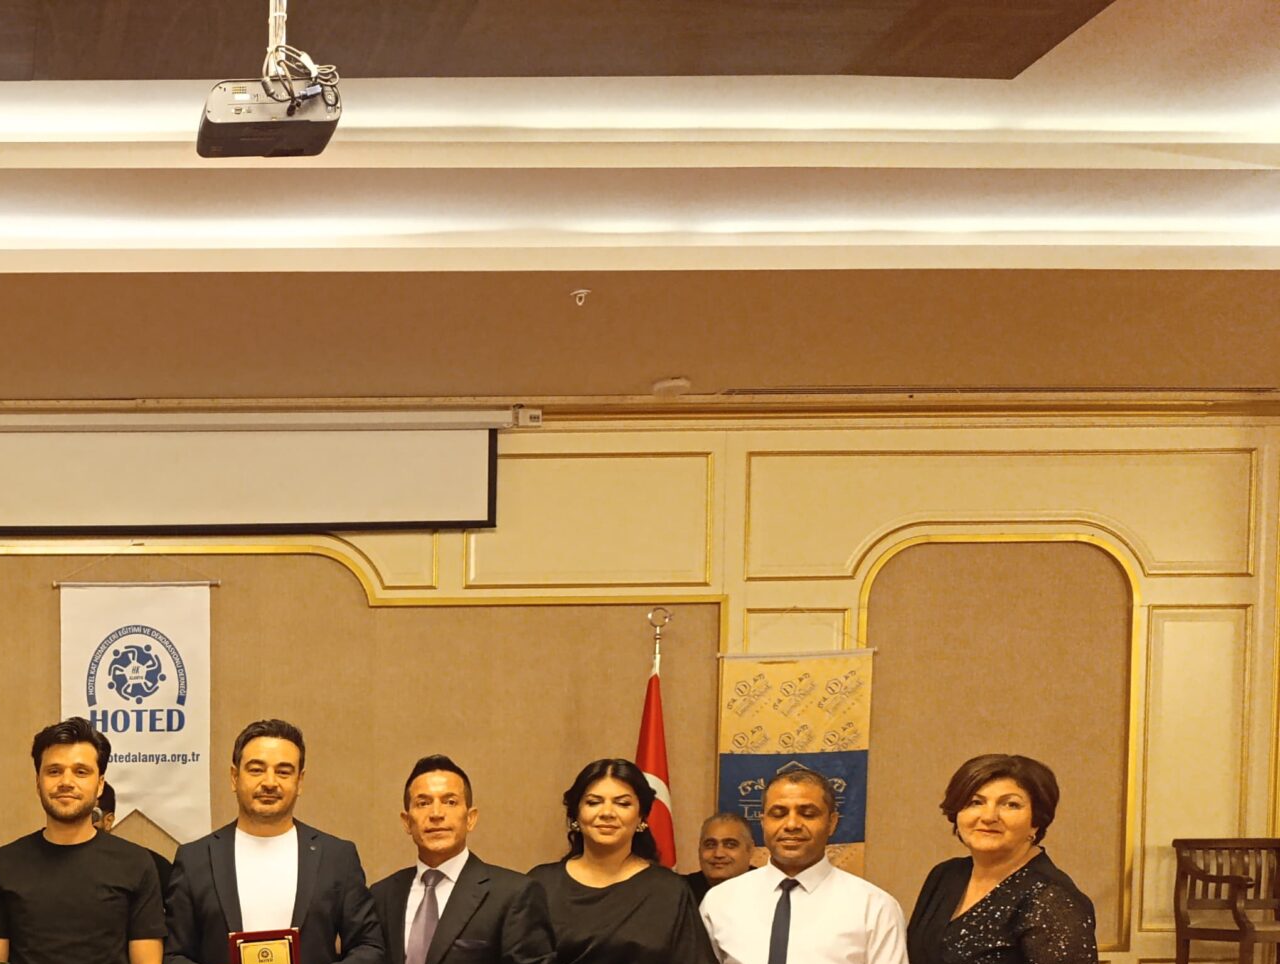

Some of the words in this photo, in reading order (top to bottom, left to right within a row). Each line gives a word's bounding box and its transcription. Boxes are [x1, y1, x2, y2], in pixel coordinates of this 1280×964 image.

[90, 662, 98, 675] KAT
[142, 627, 151, 635] VE
[90, 708, 185, 732] HOTED
[108, 752, 200, 764] otedalanya.org.tr
